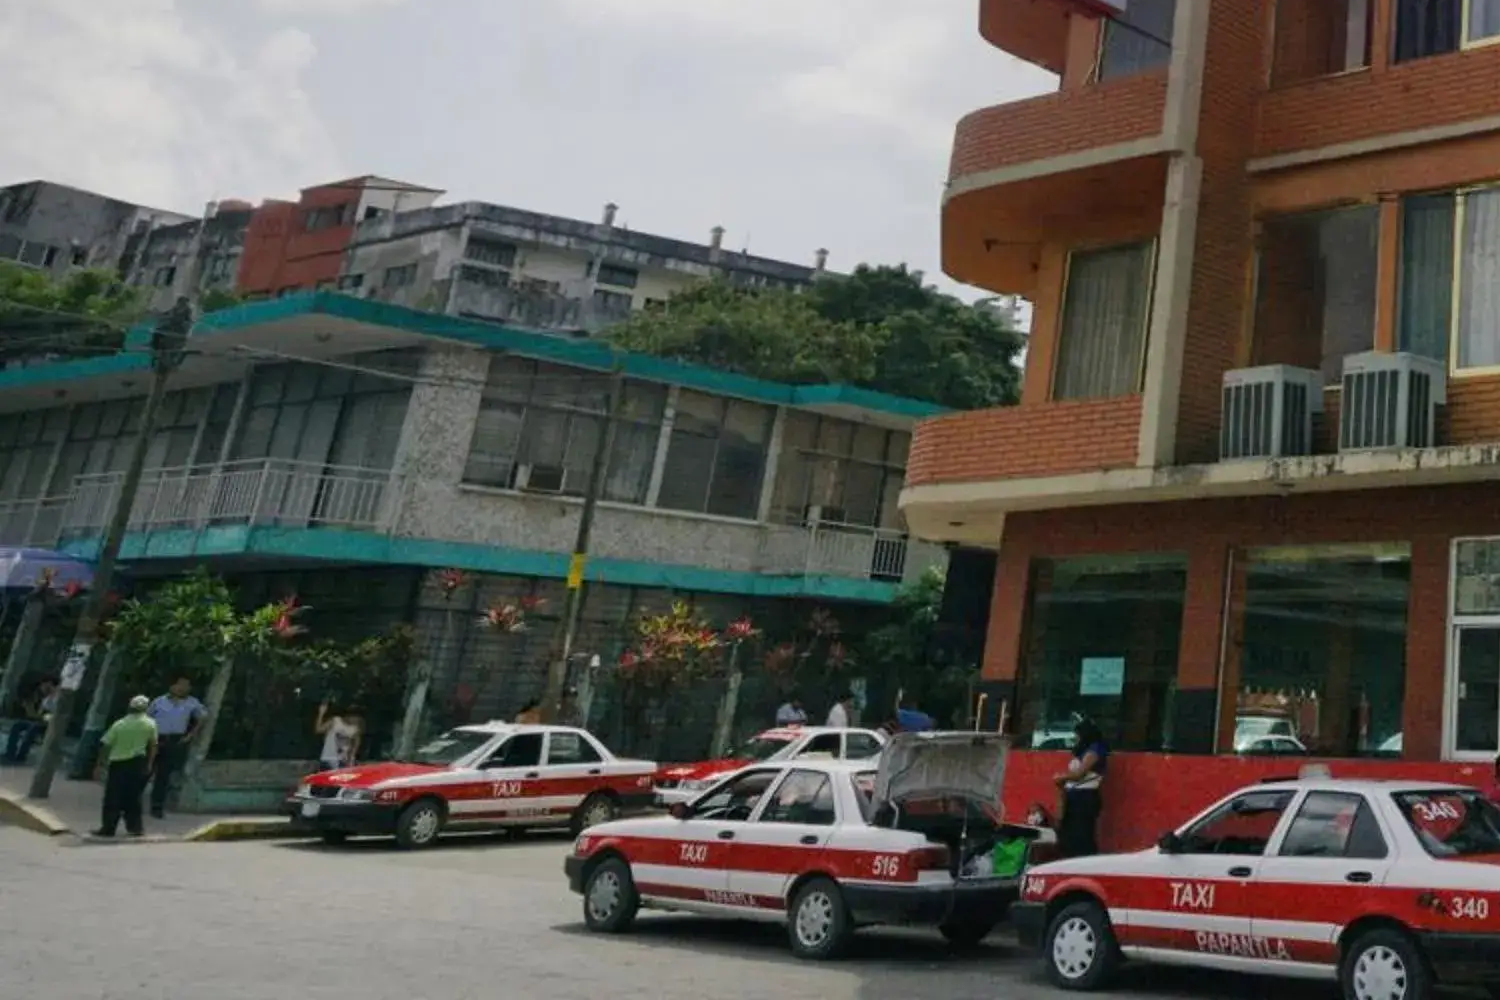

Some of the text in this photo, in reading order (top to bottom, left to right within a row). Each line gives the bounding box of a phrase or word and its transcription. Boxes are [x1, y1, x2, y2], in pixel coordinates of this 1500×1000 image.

[494, 781, 520, 797] TAXI
[1413, 801, 1460, 820] 340
[680, 843, 707, 862] TAXI
[872, 855, 899, 876] 516
[1170, 882, 1215, 909] TAXI
[1451, 896, 1489, 918] 340
[1196, 931, 1292, 959] PAPANTLA
